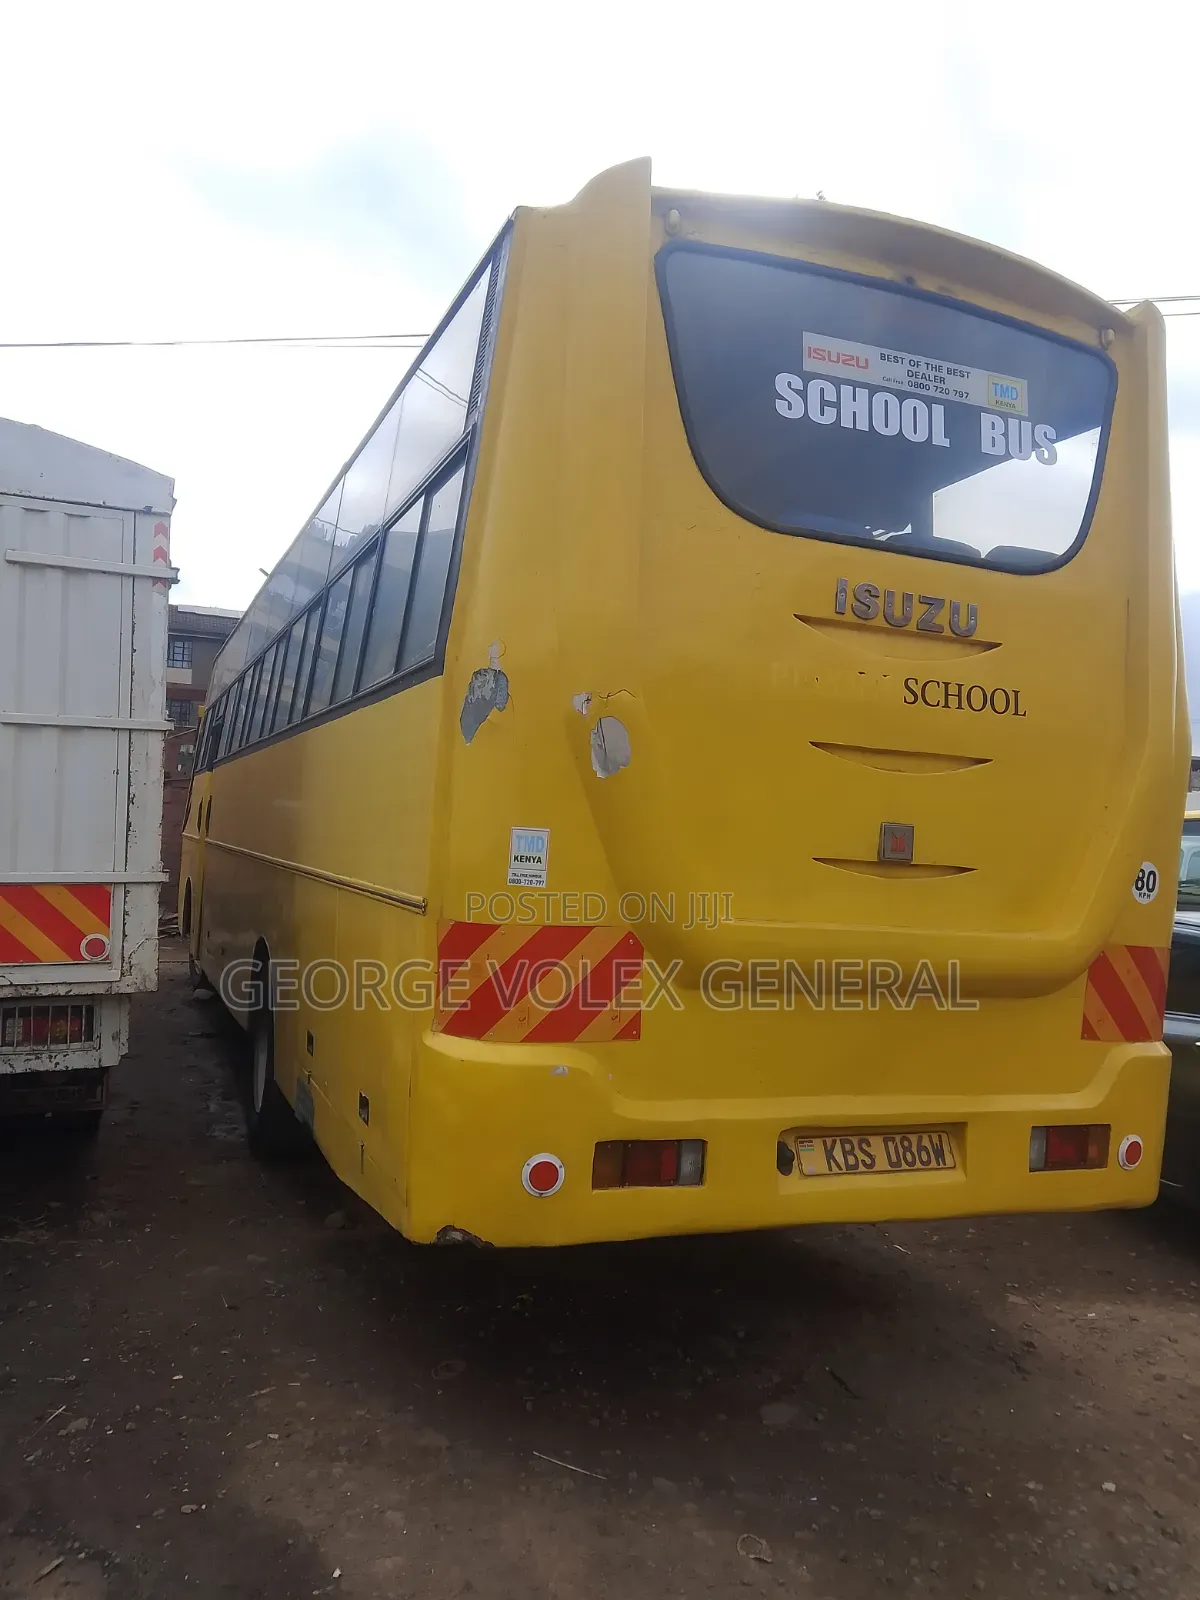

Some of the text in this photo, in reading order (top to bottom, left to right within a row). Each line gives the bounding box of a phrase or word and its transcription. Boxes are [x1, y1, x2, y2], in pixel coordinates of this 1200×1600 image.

[807, 346, 869, 370] ISUZU
[879, 352, 971, 379] BEST OF THE BEST
[906, 369, 946, 385] DEALER
[907, 380, 930, 391] 0800
[933, 385, 950, 396] 720
[953, 389, 970, 400] 797
[992, 382, 1019, 401] TMD
[995, 400, 1016, 409] KENYA
[775, 372, 1057, 466] SCHOOL BUS
[834, 577, 978, 638] ISUZU
[903, 677, 1027, 717] SCHOOL
[516, 835, 544, 852] TMD
[513, 855, 542, 864] KENYA
[1135, 868, 1157, 893] 80
[822, 1138, 877, 1172] KBS
